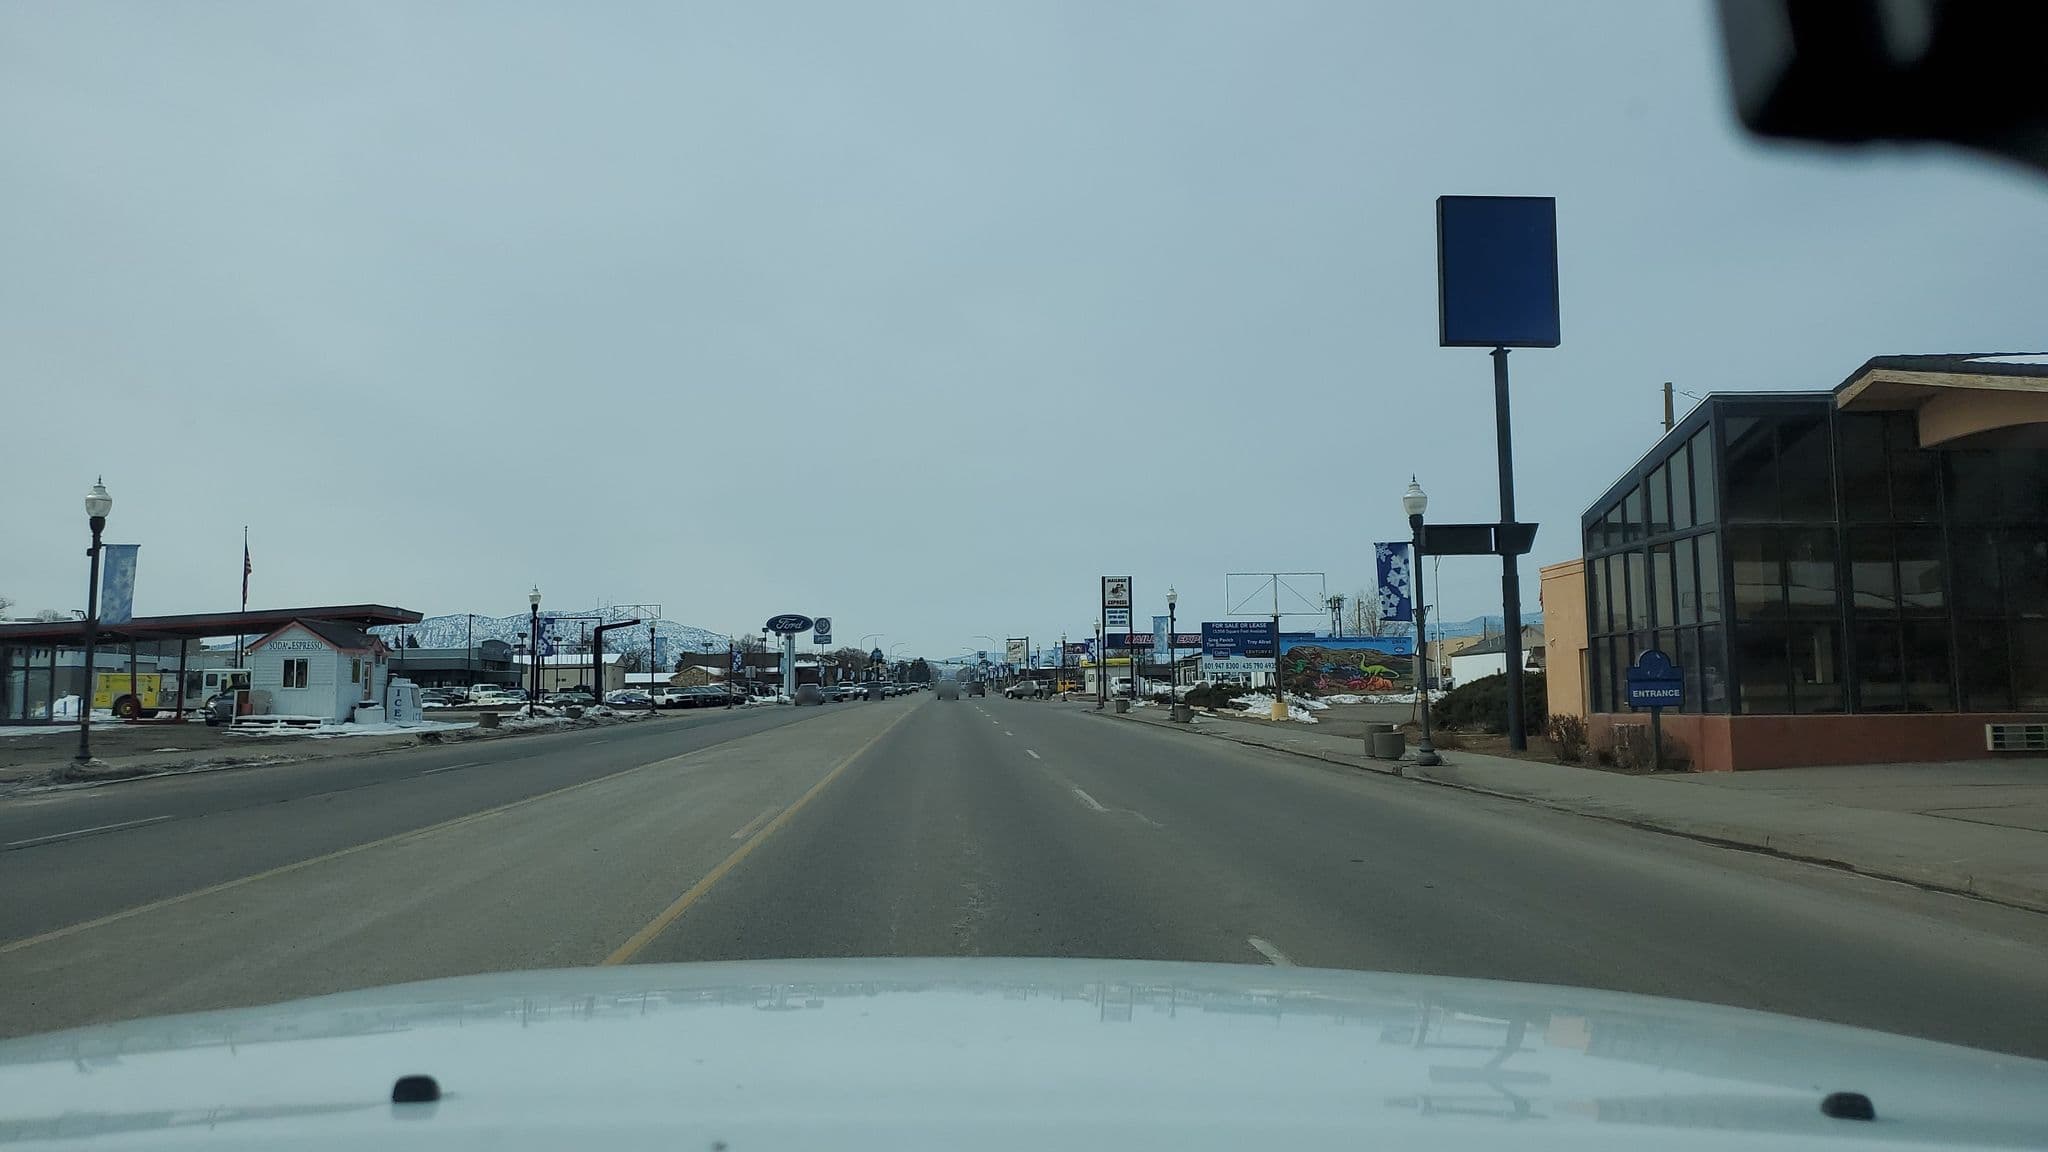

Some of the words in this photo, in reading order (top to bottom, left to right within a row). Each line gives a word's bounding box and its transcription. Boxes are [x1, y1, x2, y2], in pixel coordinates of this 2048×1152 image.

[775, 617, 804, 630] Ford
[269, 641, 288, 650] SODA
[292, 641, 323, 650] ESPRESSO
[1204, 662, 1213, 670] 801
[1214, 662, 1225, 670] 947
[1226, 662, 1240, 670] 8300
[1242, 662, 1253, 670] 435
[1632, 689, 1681, 698] ENTRANCE
[394, 688, 403, 717] ICE
